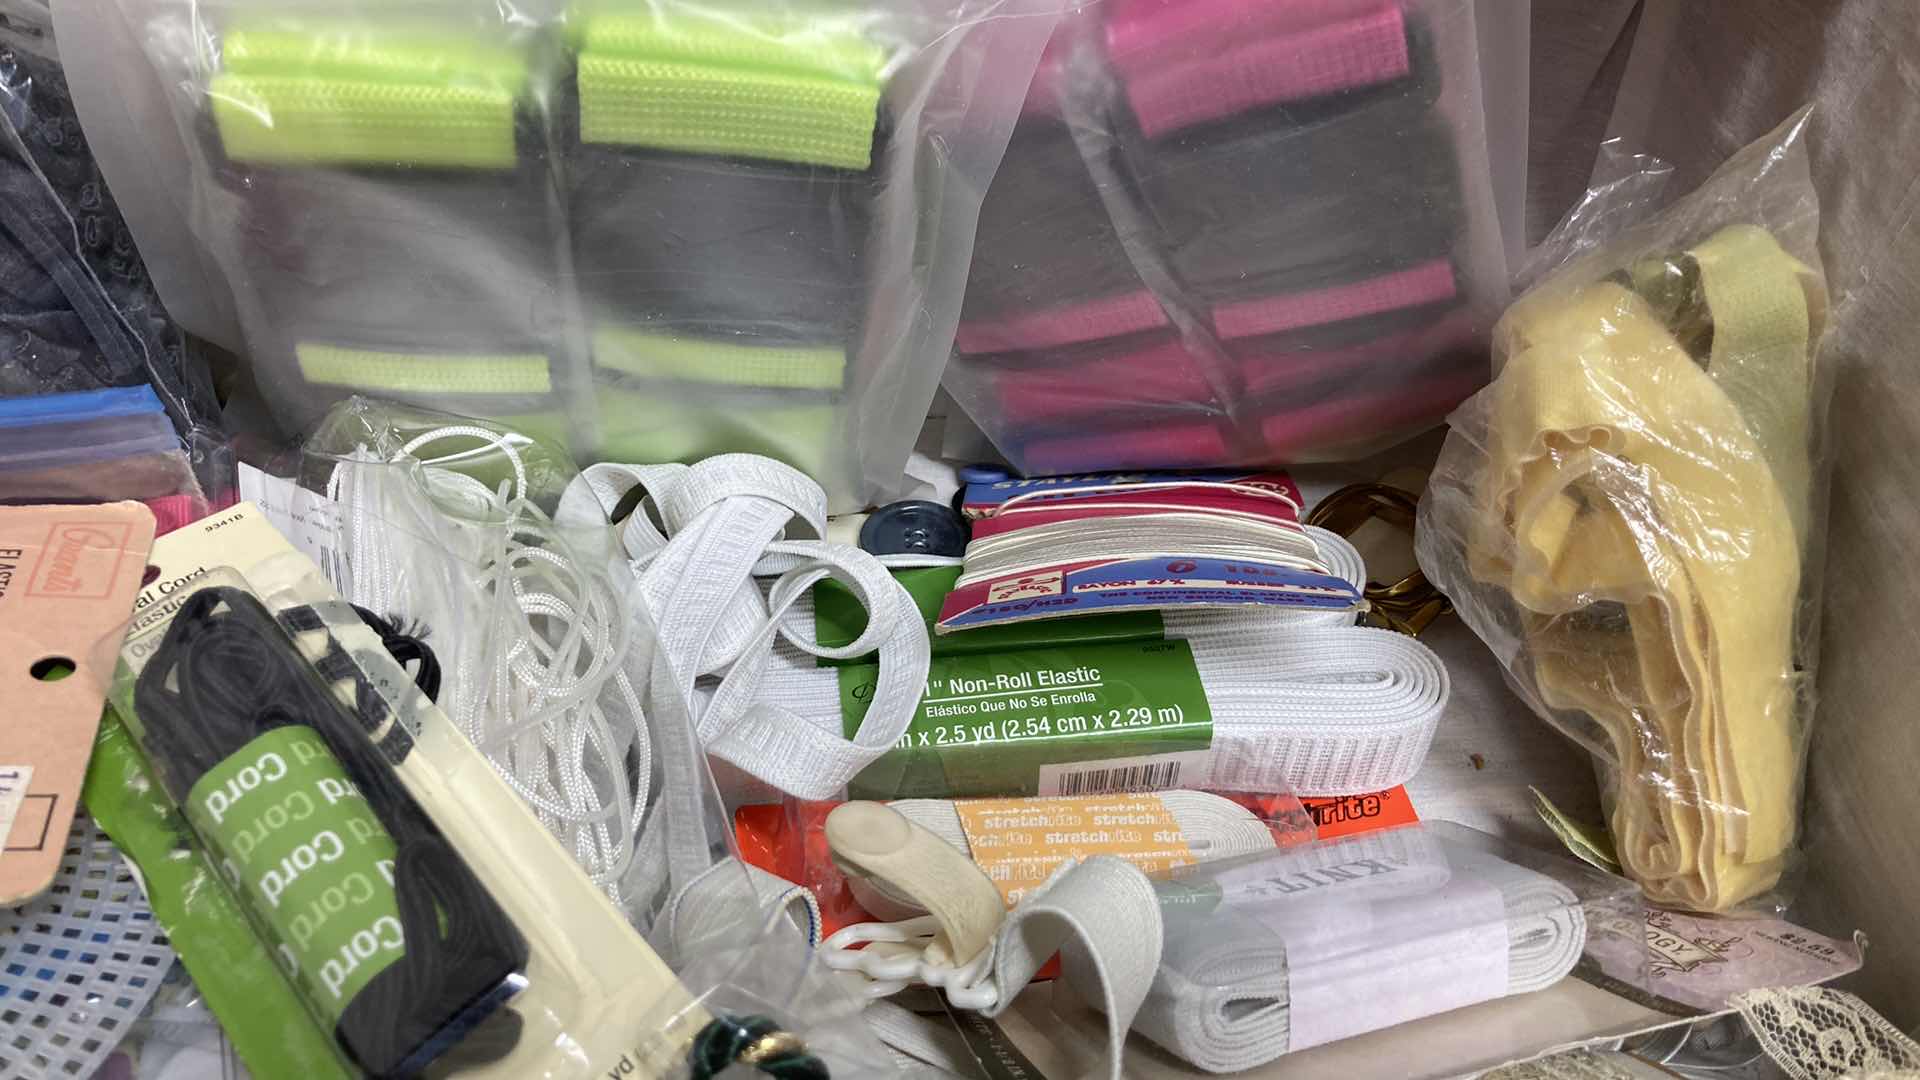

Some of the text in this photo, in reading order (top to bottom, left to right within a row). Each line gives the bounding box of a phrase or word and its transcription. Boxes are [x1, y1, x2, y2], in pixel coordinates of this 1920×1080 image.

[131, 566, 207, 613] al Cord
[1078, 580, 1137, 590] RAYON
[926, 691, 1096, 718] Elástico Que No Se Enrolla
[950, 671, 1033, 695] Non-Roll
[1037, 666, 1102, 686] Elastic
[919, 731, 930, 747] x
[935, 724, 967, 744] 2.5
[972, 721, 996, 746] yd
[1001, 717, 1052, 742] (2.54
[1057, 714, 1088, 733] cm
[1092, 714, 1105, 730] x
[1109, 706, 1151, 728] 2.29
[1158, 703, 1184, 725] m)
[205, 751, 288, 824] Cord
[232, 790, 316, 865] Cord
[259, 830, 345, 908] Cord
[288, 872, 375, 952] Cord
[320, 915, 406, 999] Cord
